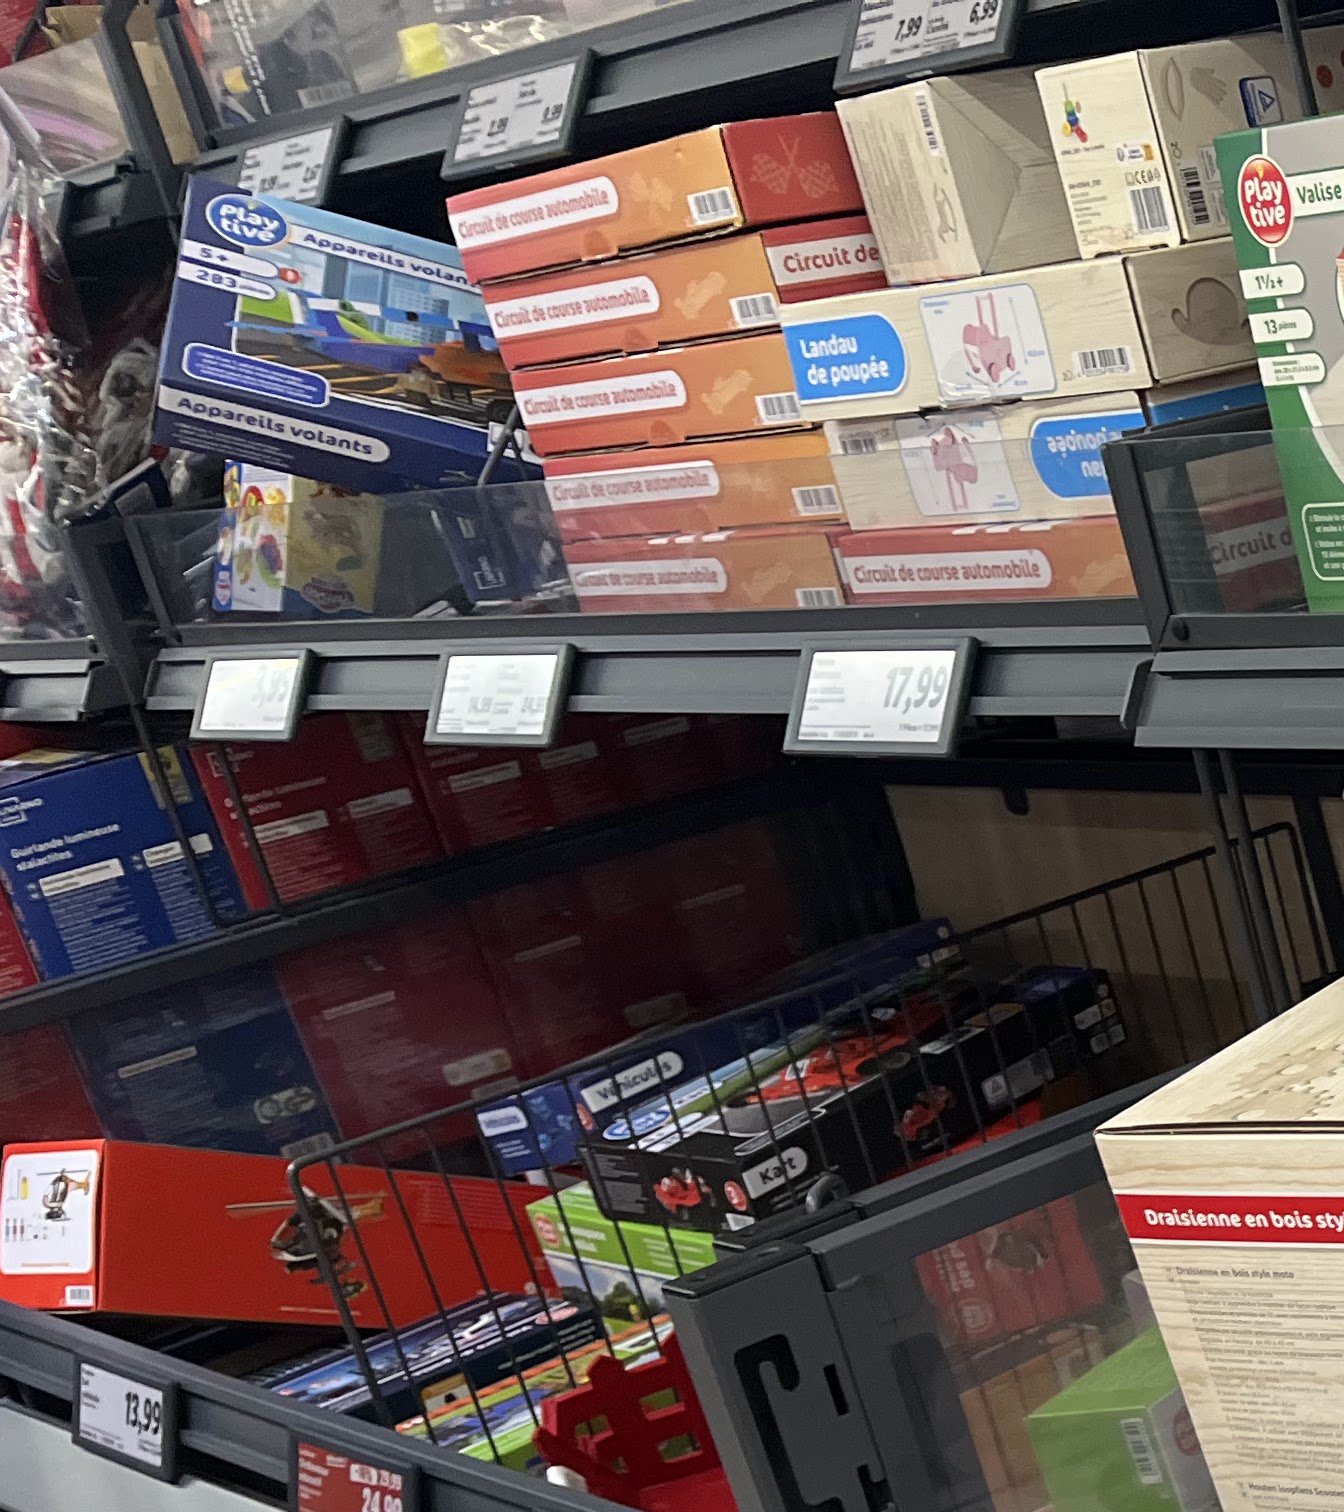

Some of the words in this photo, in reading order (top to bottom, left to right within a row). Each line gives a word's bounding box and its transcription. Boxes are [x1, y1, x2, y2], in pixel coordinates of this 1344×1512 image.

[1244, 177, 1282, 203] Play
[1297, 182, 1342, 203] Valise
[220, 205, 279, 232] Play
[1250, 204, 1285, 227] tive
[221, 220, 274, 242] tive
[304, 232, 405, 268] Appareils
[783, 246, 850, 273] Circuit
[800, 334, 858, 358] Landau
[807, 364, 827, 385] de
[831, 355, 889, 386] poupée
[178, 398, 285, 433] Appareils
[290, 422, 371, 454] volants
[854, 563, 896, 585] Circuit
[901, 563, 914, 581] de
[917, 561, 959, 580] course
[962, 558, 1040, 579] automobile
[884, 666, 947, 714] 17,99
[1144, 1208, 1242, 1228] Draisienne
[1246, 1212, 1269, 1228] en
[1275, 1210, 1314, 1229] bois
[125, 1391, 162, 1434] 13,99
